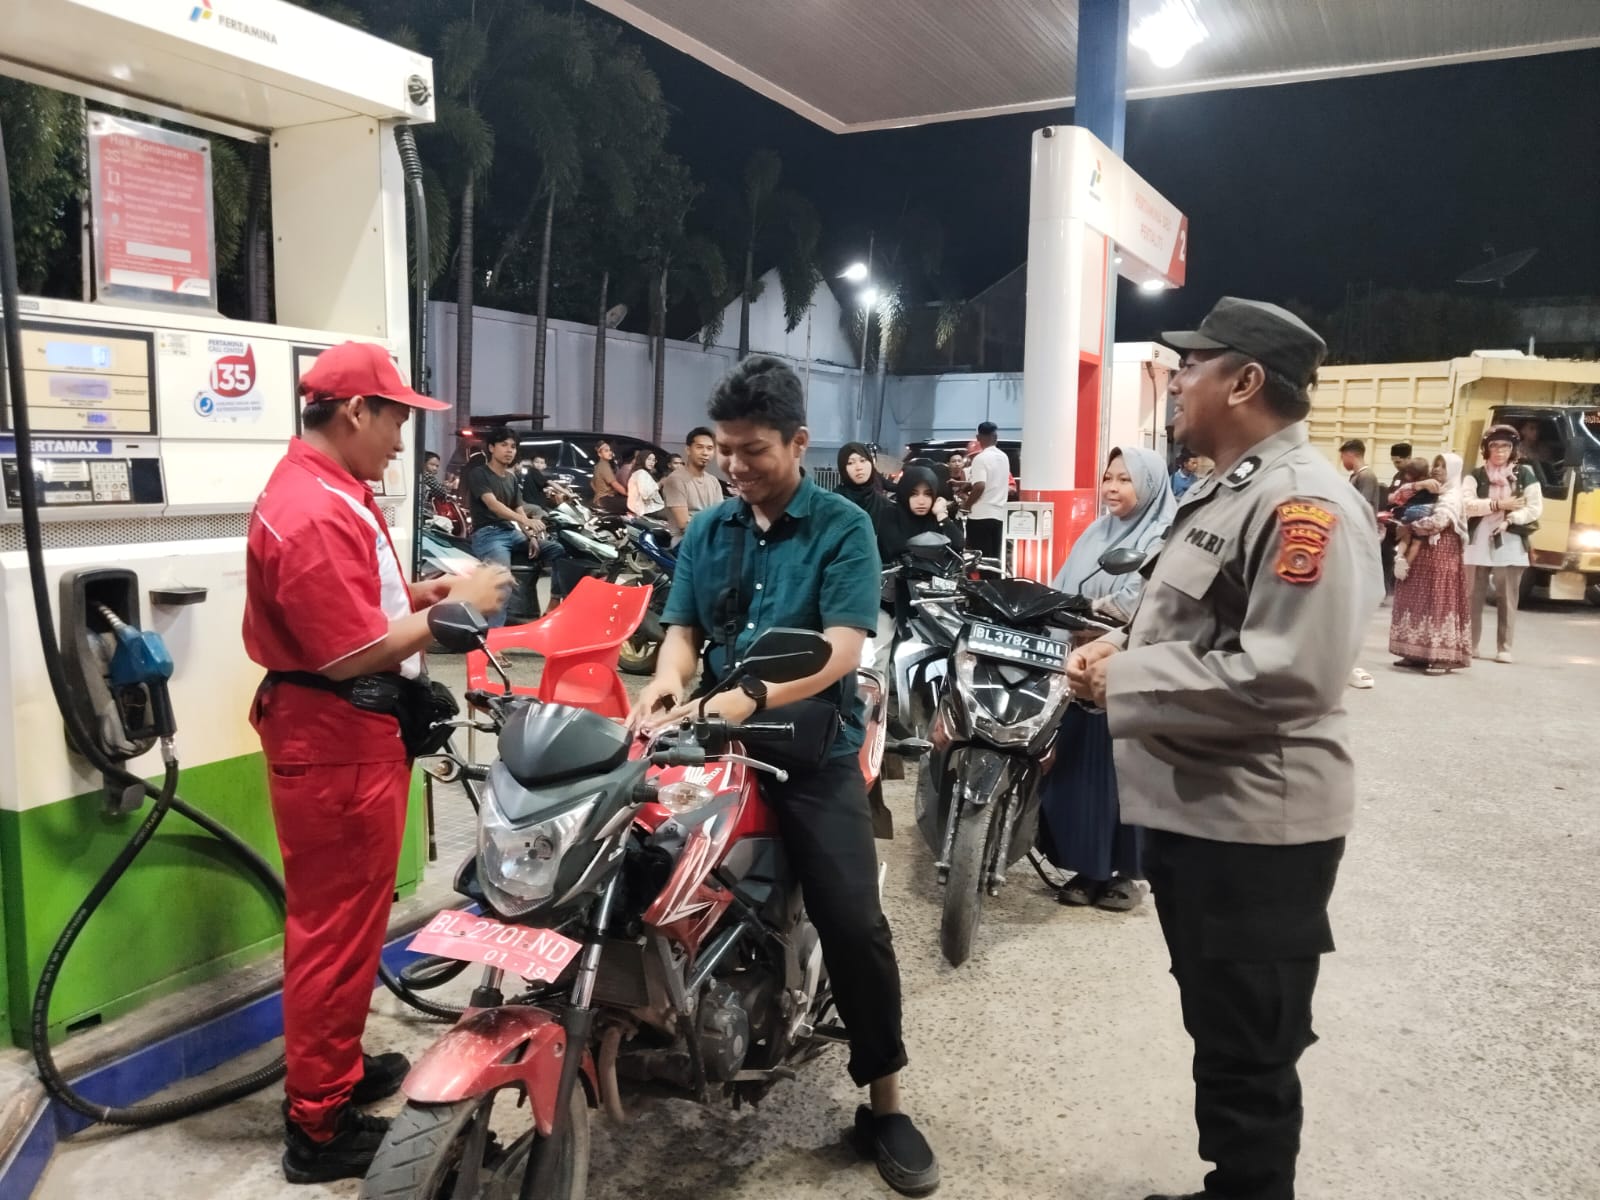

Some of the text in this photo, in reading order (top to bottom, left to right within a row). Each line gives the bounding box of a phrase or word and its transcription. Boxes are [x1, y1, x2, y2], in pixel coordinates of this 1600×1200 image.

[218, 15, 278, 45] PERTAMINA
[1179, 229, 1187, 262] 2
[211, 362, 251, 391] 135
[1184, 528, 1225, 555] POLRI
[430, 914, 570, 964] BL 2701 ND
